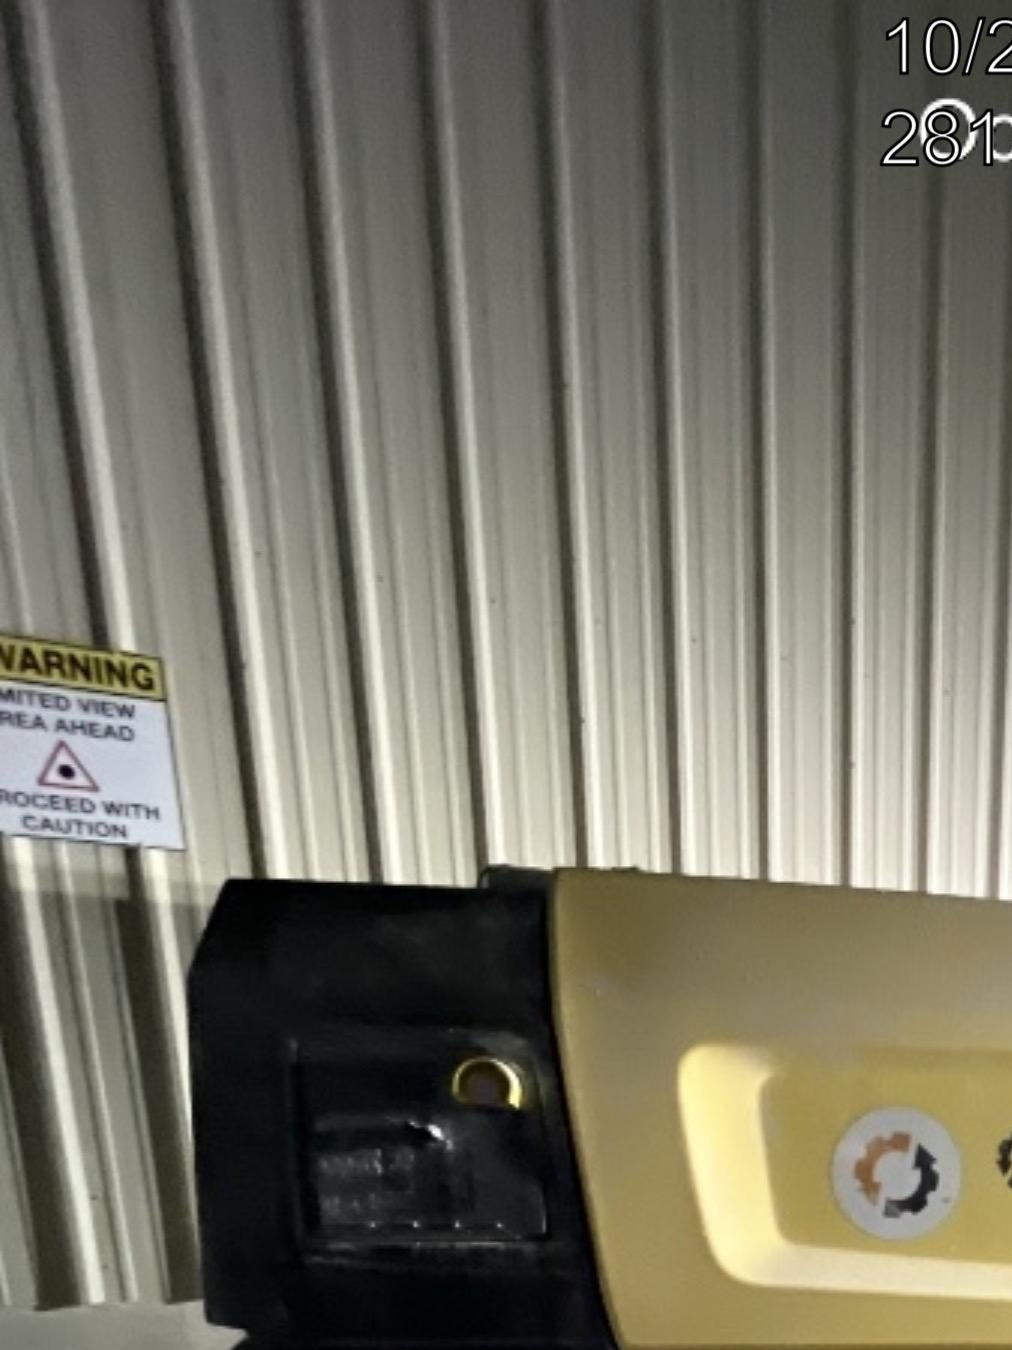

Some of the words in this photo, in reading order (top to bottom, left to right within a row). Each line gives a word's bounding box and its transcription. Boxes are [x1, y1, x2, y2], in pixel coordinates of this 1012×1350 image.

[0, 689, 71, 711] MITED
[79, 699, 136, 719] VIEW
[0, 711, 47, 732] REA
[55, 717, 135, 742] AHEAD
[0, 788, 96, 814] ROCEED
[102, 801, 160, 820] WITH
[21, 815, 128, 839] CAUTION
